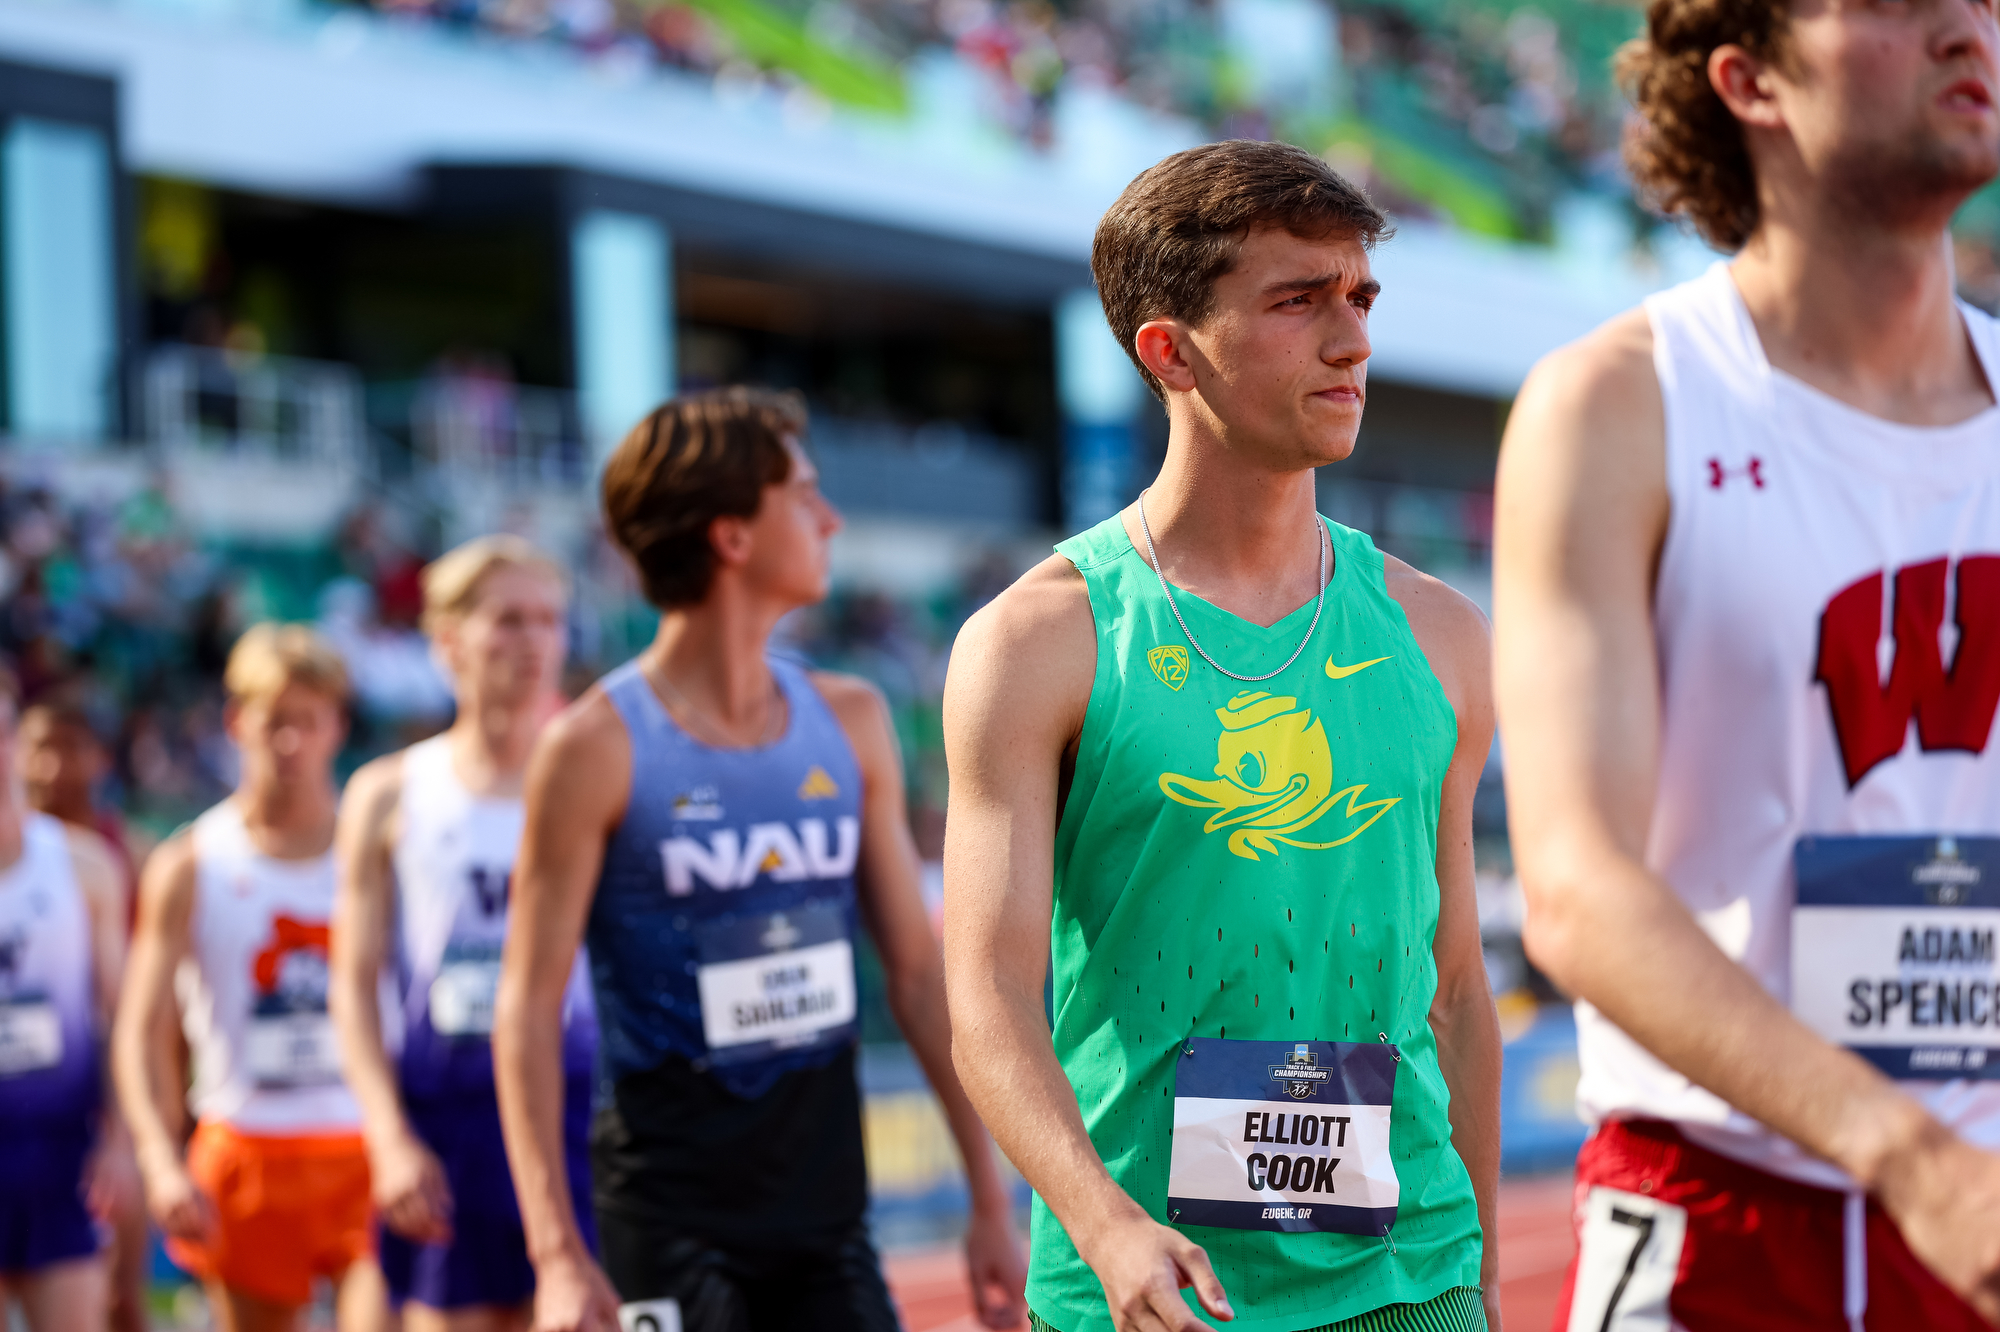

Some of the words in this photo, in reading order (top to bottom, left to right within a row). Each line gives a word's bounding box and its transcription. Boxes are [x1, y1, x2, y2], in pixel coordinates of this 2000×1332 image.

[1150, 648, 1187, 674] PAC
[1162, 665, 1184, 681] 12
[1812, 554, 2000, 795] W
[660, 816, 860, 897] NAU
[1899, 924, 1995, 963] ADAM
[1274, 1069, 1327, 1079] CHAMPIONSHIPS
[1243, 1111, 1351, 1148] ELLIOTT
[1246, 1152, 1341, 1194] COOK
[1261, 1207, 1297, 1220] EUGENE,
[1297, 1207, 1313, 1219] OR
[1599, 1205, 1656, 1332] 7
